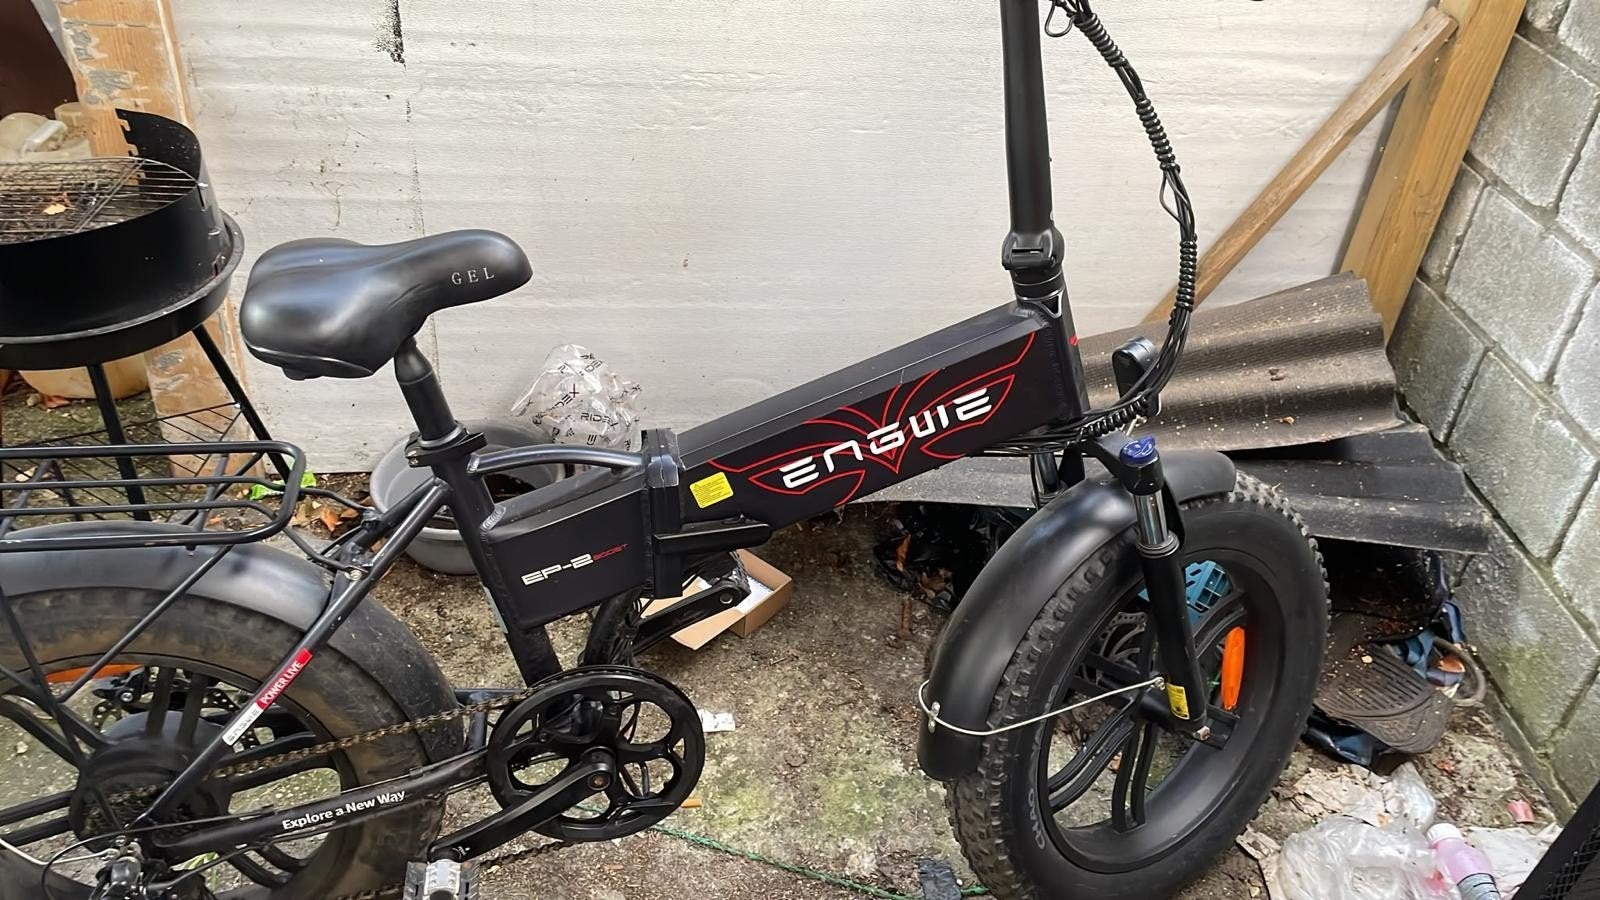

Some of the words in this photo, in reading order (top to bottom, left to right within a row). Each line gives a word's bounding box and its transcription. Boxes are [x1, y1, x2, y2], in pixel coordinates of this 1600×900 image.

[451, 267, 495, 285] GEL
[521, 553, 594, 586] EP-2
[260, 676, 288, 705] POWER
[283, 660, 303, 680] LIVE
[281, 810, 334, 830] Explore
[335, 807, 345, 817] a
[345, 798, 376, 814] New
[376, 790, 406, 805] Way
